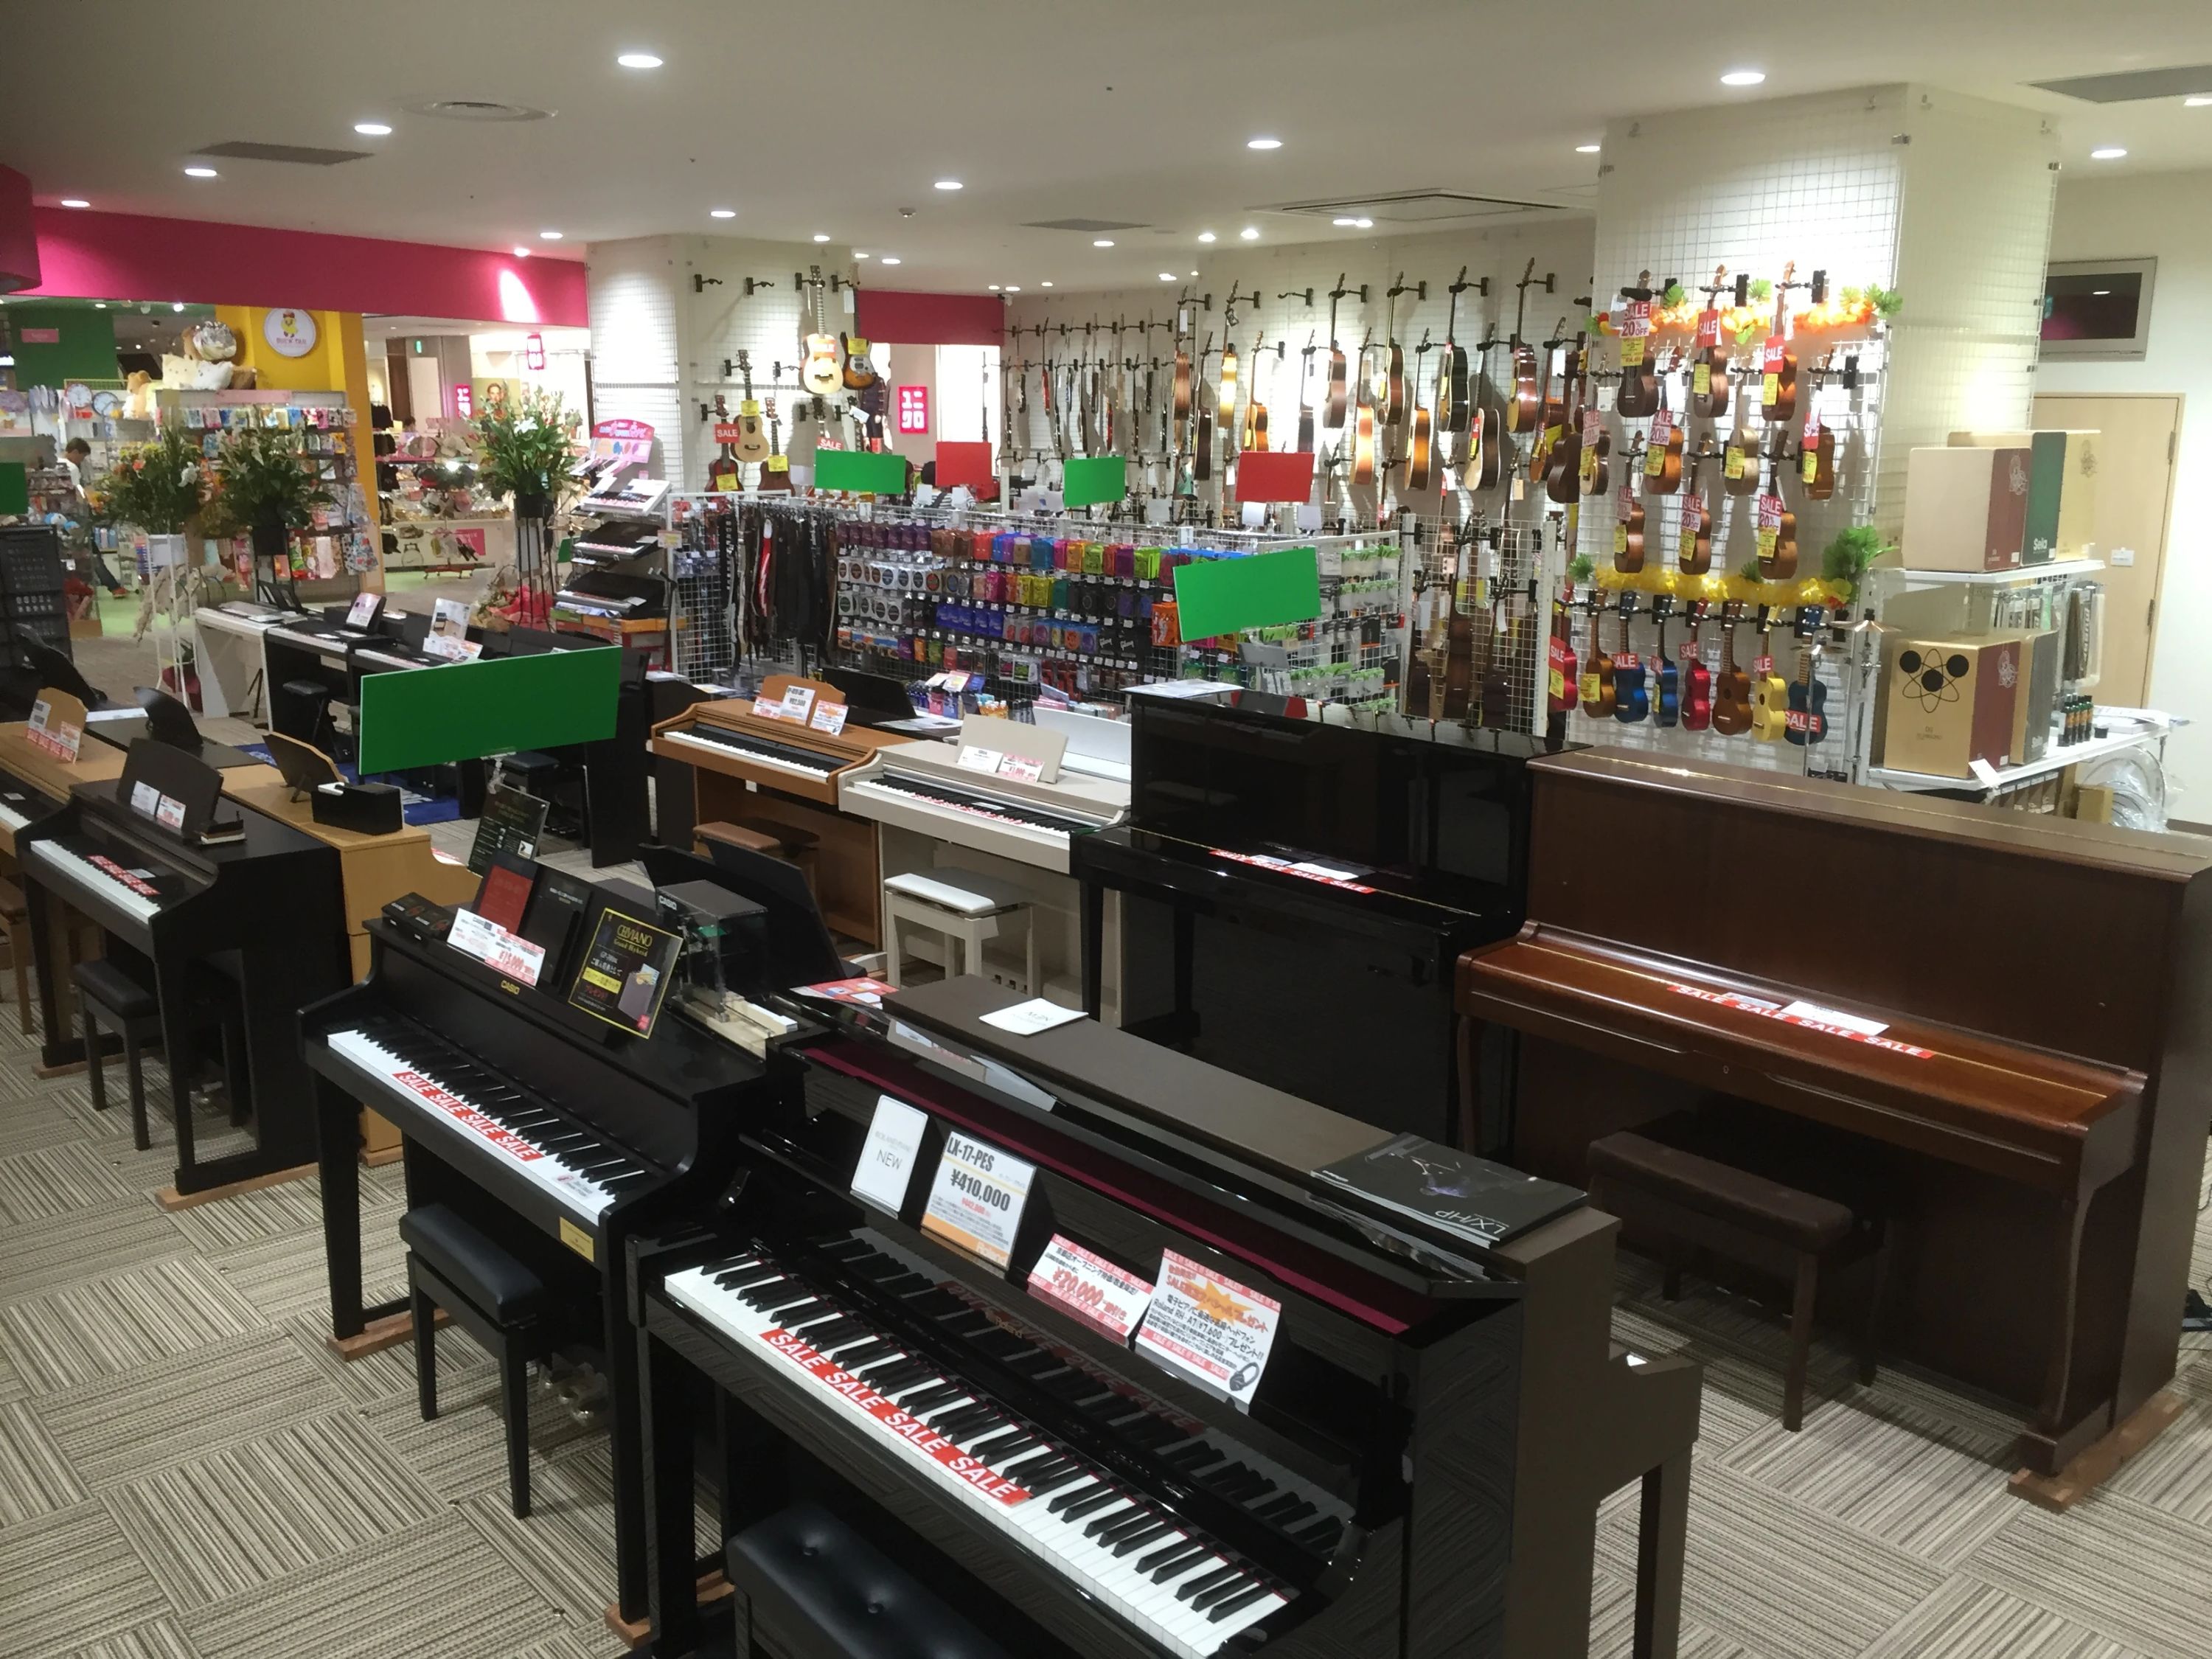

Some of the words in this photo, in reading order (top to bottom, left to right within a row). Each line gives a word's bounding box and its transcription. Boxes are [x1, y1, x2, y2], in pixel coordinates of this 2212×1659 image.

[1624, 303, 1649, 319] SALE
[1699, 319, 1717, 336] SALE
[1765, 346, 1783, 363] SALE
[1654, 411, 1671, 425] SALE
[717, 429, 737, 437] SALE
[820, 439, 842, 450] SALE
[1683, 498, 1701, 512] SALE
[1761, 496, 1781, 515] SALE
[1550, 645, 1565, 663] SALE
[1681, 644, 1697, 658] SALE
[1753, 658, 1771, 672] SALE
[1785, 712, 1818, 730] SALE
[1291, 870, 1325, 882] SALE
[1329, 880, 1368, 893] SALE
[501, 979, 520, 995] CASIO
[1676, 987, 1729, 1004] SALE
[1735, 1003, 1790, 1020] SALE
[1798, 1020, 1854, 1037] SALE
[1863, 1037, 1924, 1055] SALE
[398, 1073, 436, 1096] SALE
[428, 1093, 467, 1114] SALE
[460, 1113, 501, 1136] SALE
[495, 1135, 537, 1158] SALE
[876, 1149, 903, 1170] NEW
[946, 1136, 995, 1172] LX-17-PES
[950, 1169, 1011, 1211] ¥410,000
[1435, 1210, 1506, 1234] LX/HP
[770, 1334, 827, 1368] SALE
[825, 1372, 886, 1409] SALE
[885, 1412, 950, 1453] SALE
[949, 1456, 1018, 1498] SALE
